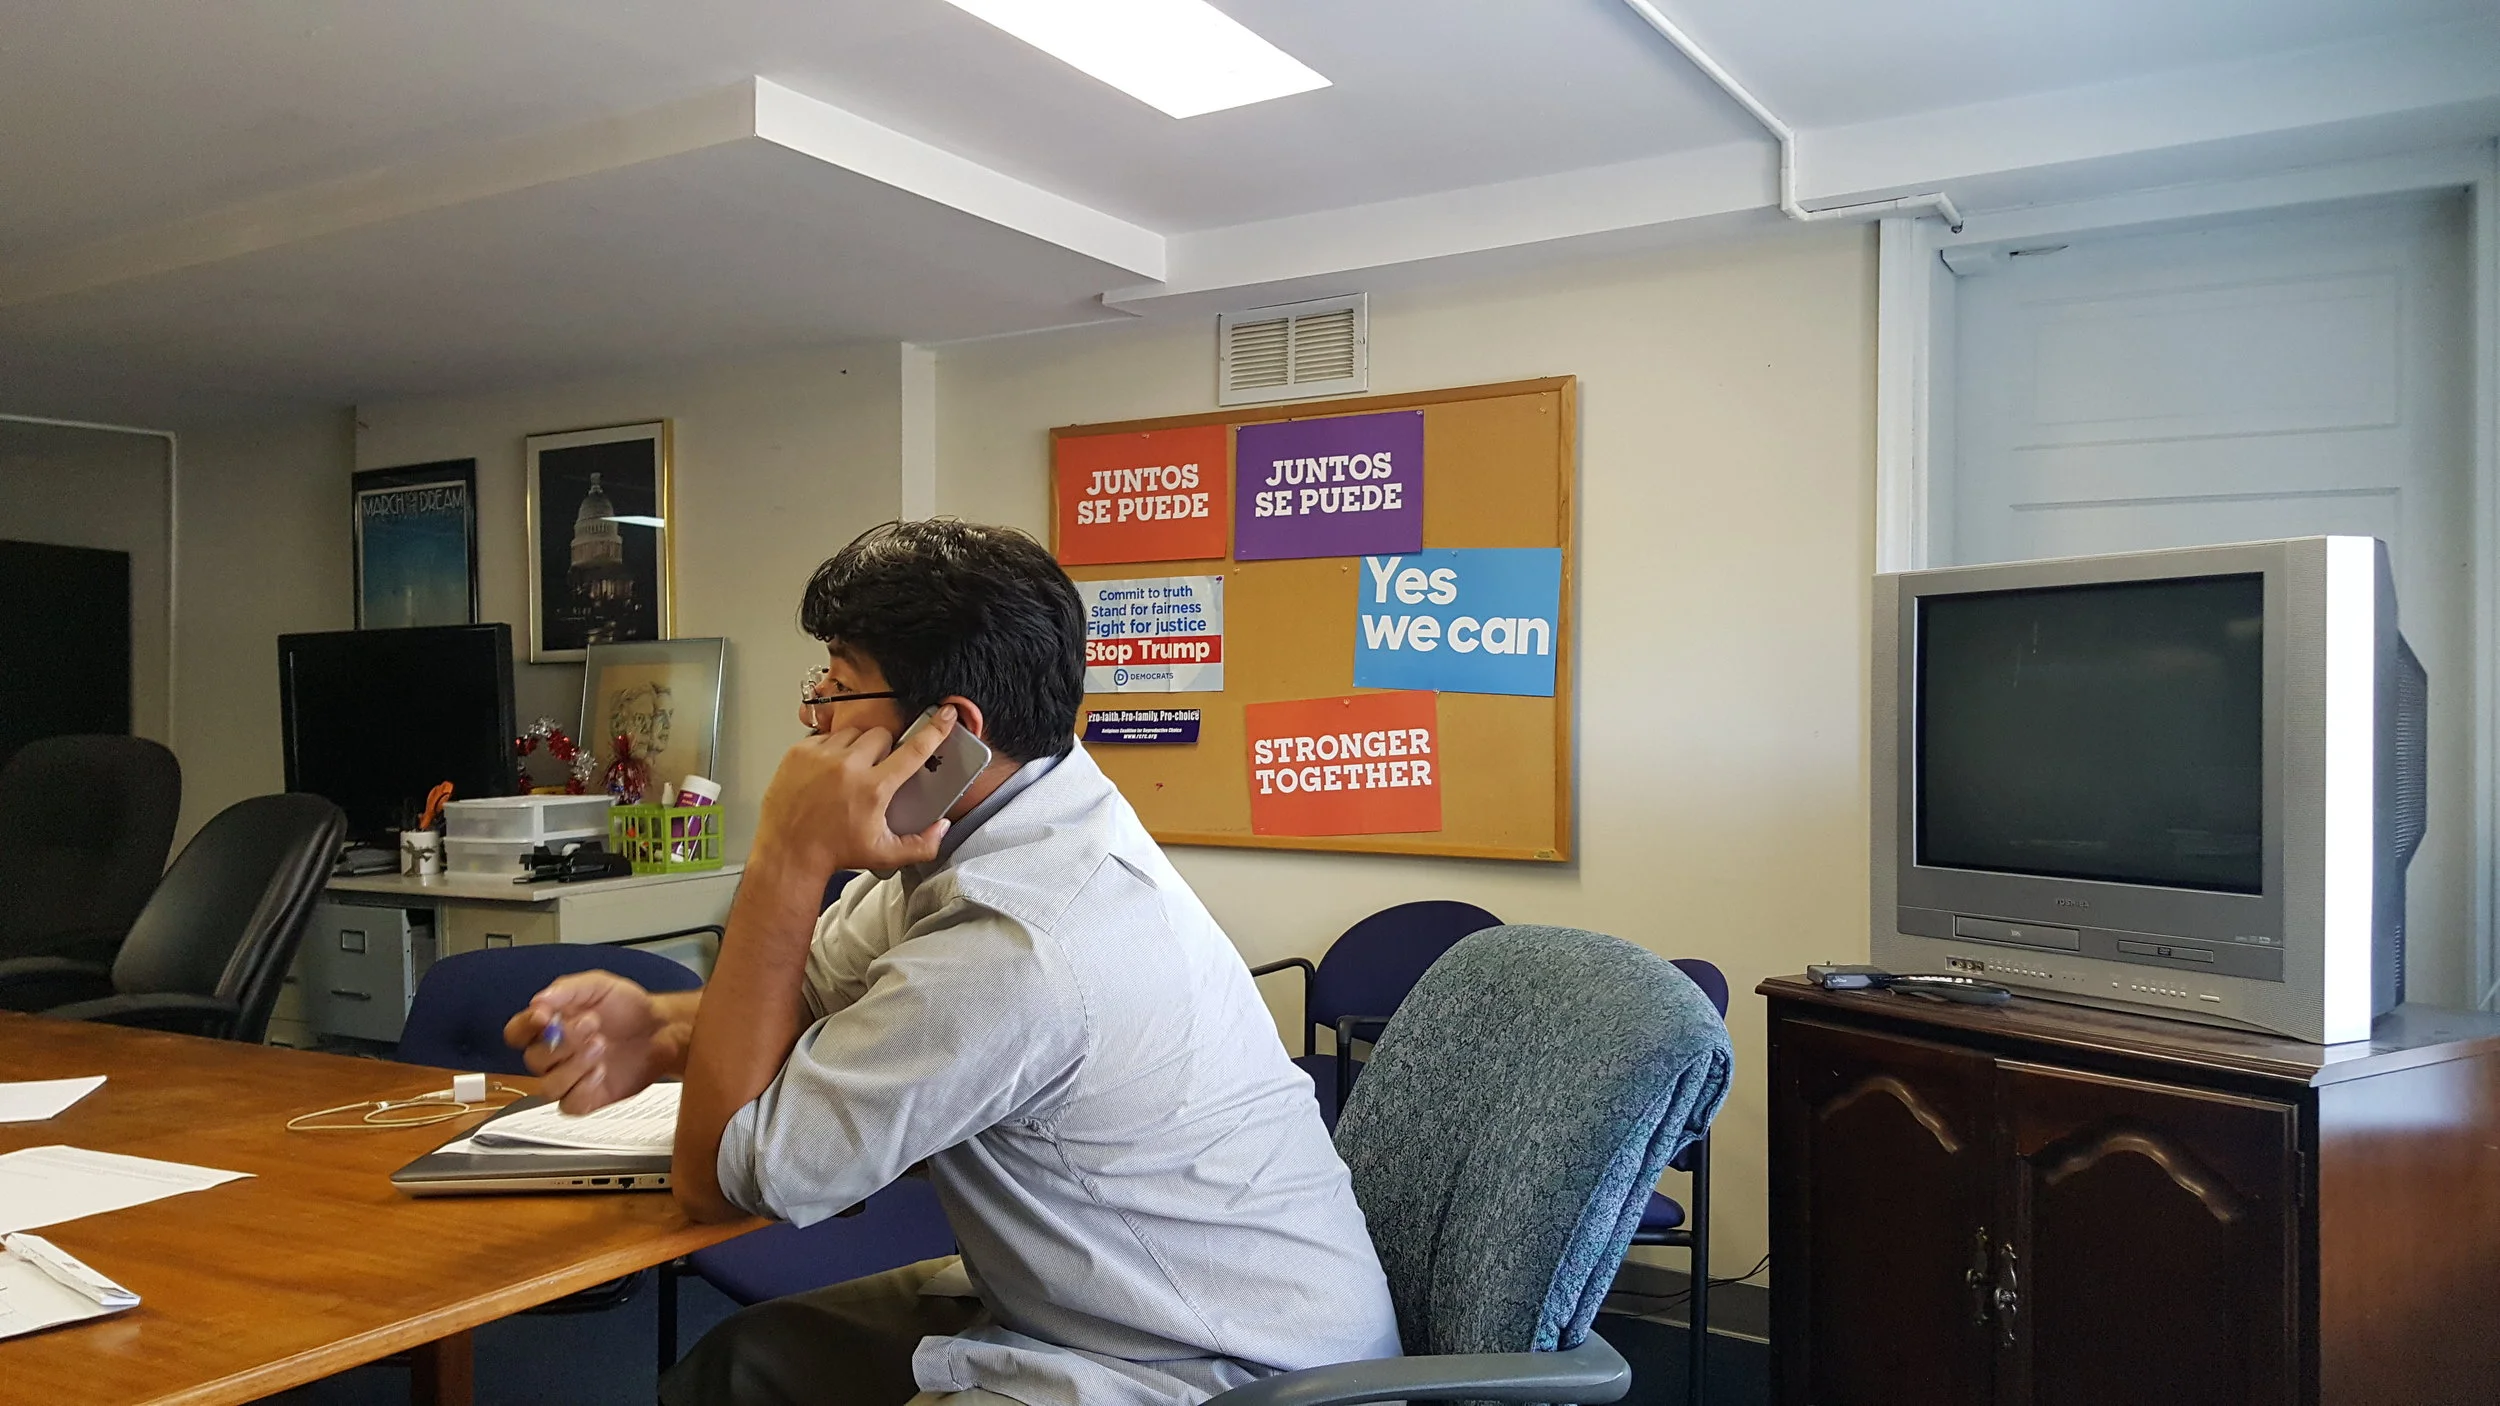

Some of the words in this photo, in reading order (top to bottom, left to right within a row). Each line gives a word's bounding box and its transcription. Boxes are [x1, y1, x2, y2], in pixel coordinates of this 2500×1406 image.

[1086, 463, 1199, 495] JUNTOS
[1265, 452, 1392, 486] JUNTOS
[419, 488, 463, 512] DREAM
[1077, 500, 1111, 525] SE
[1117, 492, 1209, 523] PUEDE
[1255, 490, 1292, 518] SE
[1300, 482, 1402, 515] PUEDE
[1099, 588, 1144, 601] Commit
[1148, 588, 1160, 599] to
[1163, 585, 1192, 597] truth
[1365, 556, 1457, 605] Yes
[1091, 604, 1126, 618] Stand
[1131, 604, 1148, 615] for
[1152, 602, 1201, 614] fairness
[1088, 620, 1125, 637] Fight
[1130, 619, 1151, 633] for
[1155, 617, 1207, 635] justice
[1362, 615, 1440, 652] we
[1447, 616, 1549, 655] can
[1086, 642, 1133, 664] Stop
[1138, 640, 1210, 662] Trump
[1130, 672, 1174, 680] DEMOCRATS
[1121, 710, 1159, 722] Pro-family,
[1160, 709, 1199, 721] Pro-choice
[1255, 728, 1430, 764] STRONGER
[1256, 760, 1432, 795] TOGETHER
